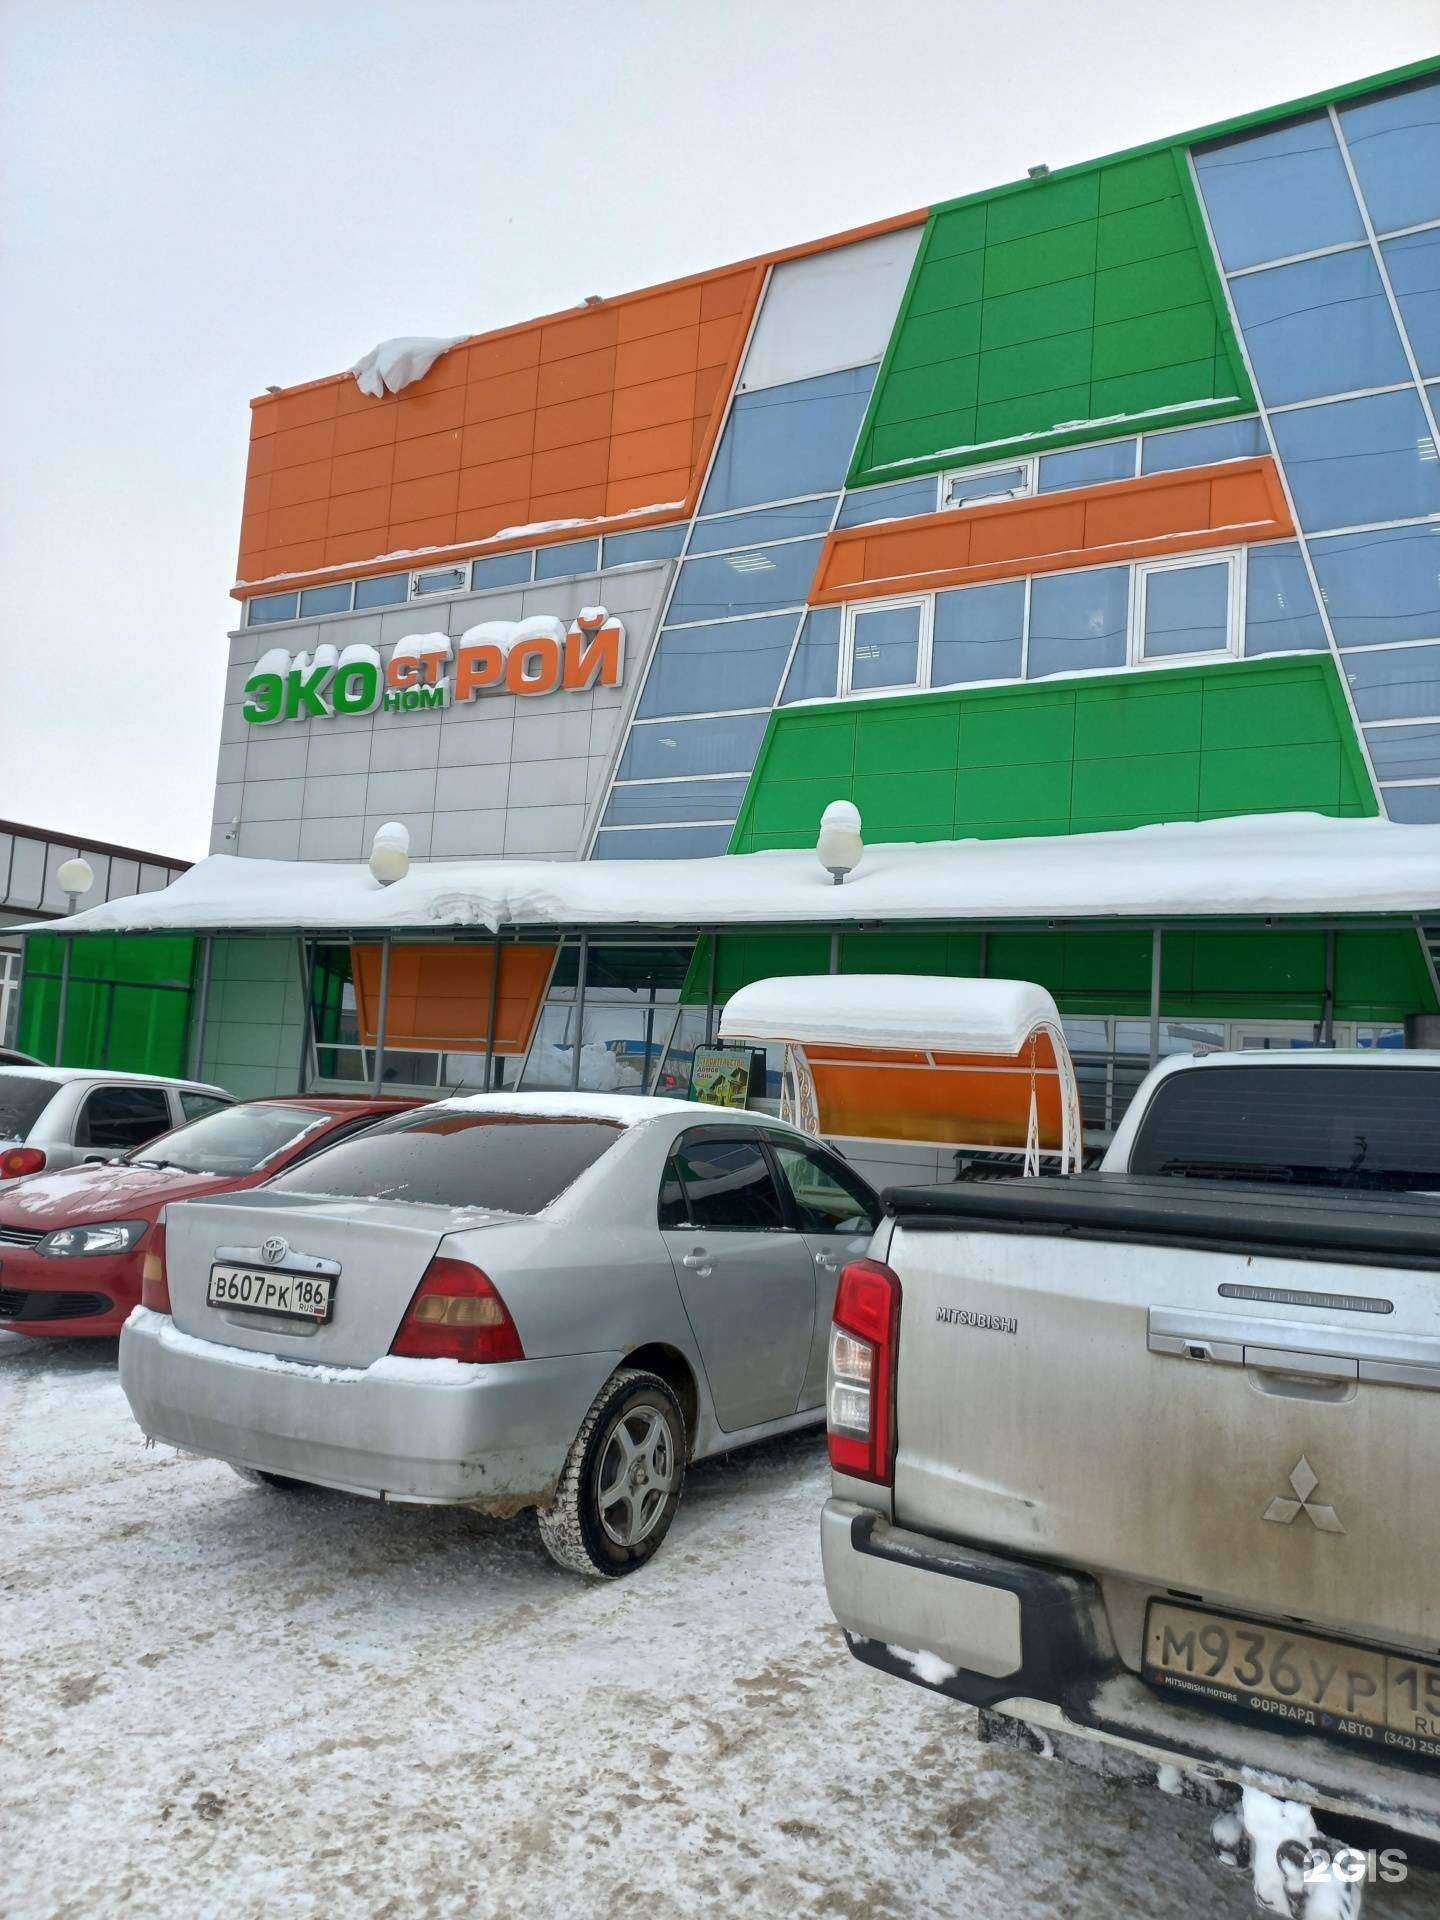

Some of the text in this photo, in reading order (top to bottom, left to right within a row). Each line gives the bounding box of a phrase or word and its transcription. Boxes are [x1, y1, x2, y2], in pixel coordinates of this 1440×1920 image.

[295, 1281, 323, 1305] 186
[298, 1304, 314, 1313] RUS
[935, 1306, 1018, 1334] MITSUBISHI
[1165, 1677, 1238, 1702] MITSUBISHI MOTORS
[1250, 1696, 1315, 1726] ФОРВАРД
[1338, 1719, 1374, 1739] АВТО
